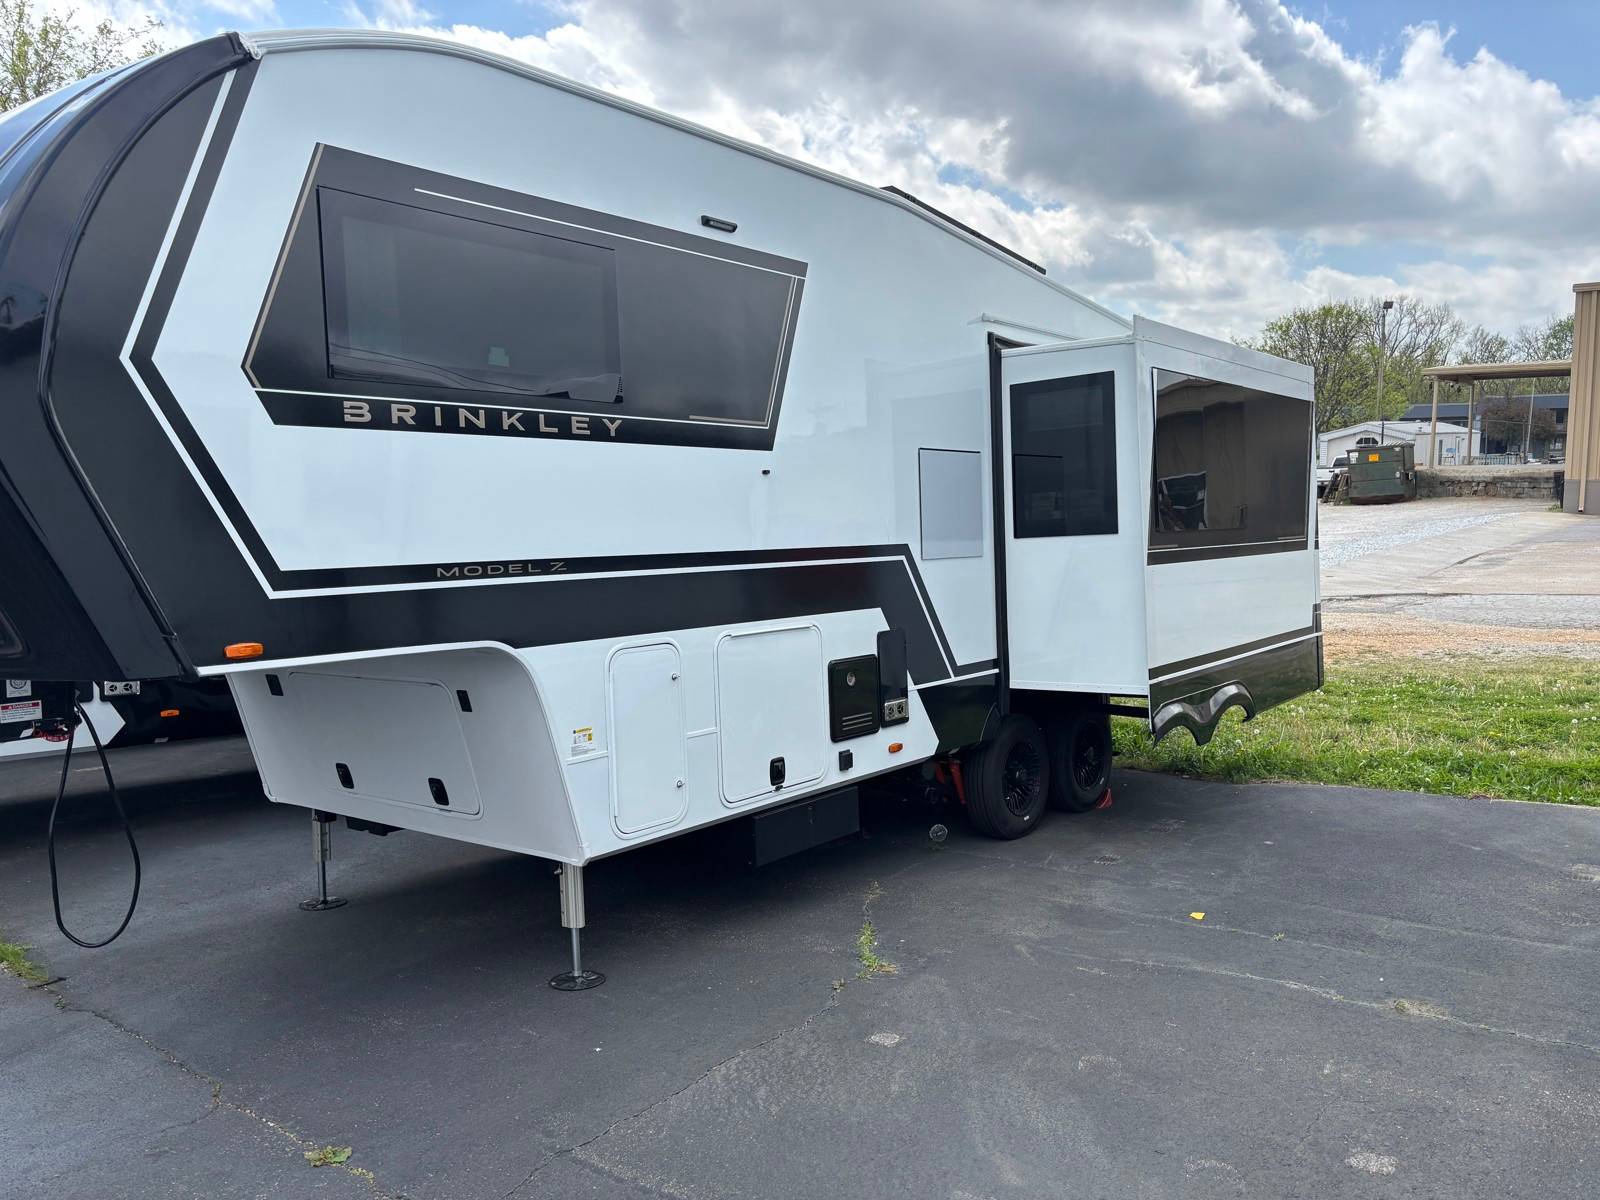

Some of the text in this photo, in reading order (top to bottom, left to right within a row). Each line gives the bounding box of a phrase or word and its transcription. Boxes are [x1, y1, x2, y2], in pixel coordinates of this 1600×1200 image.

[343, 400, 623, 437] BRINKLEY
[437, 561, 568, 577] MODEL Z
